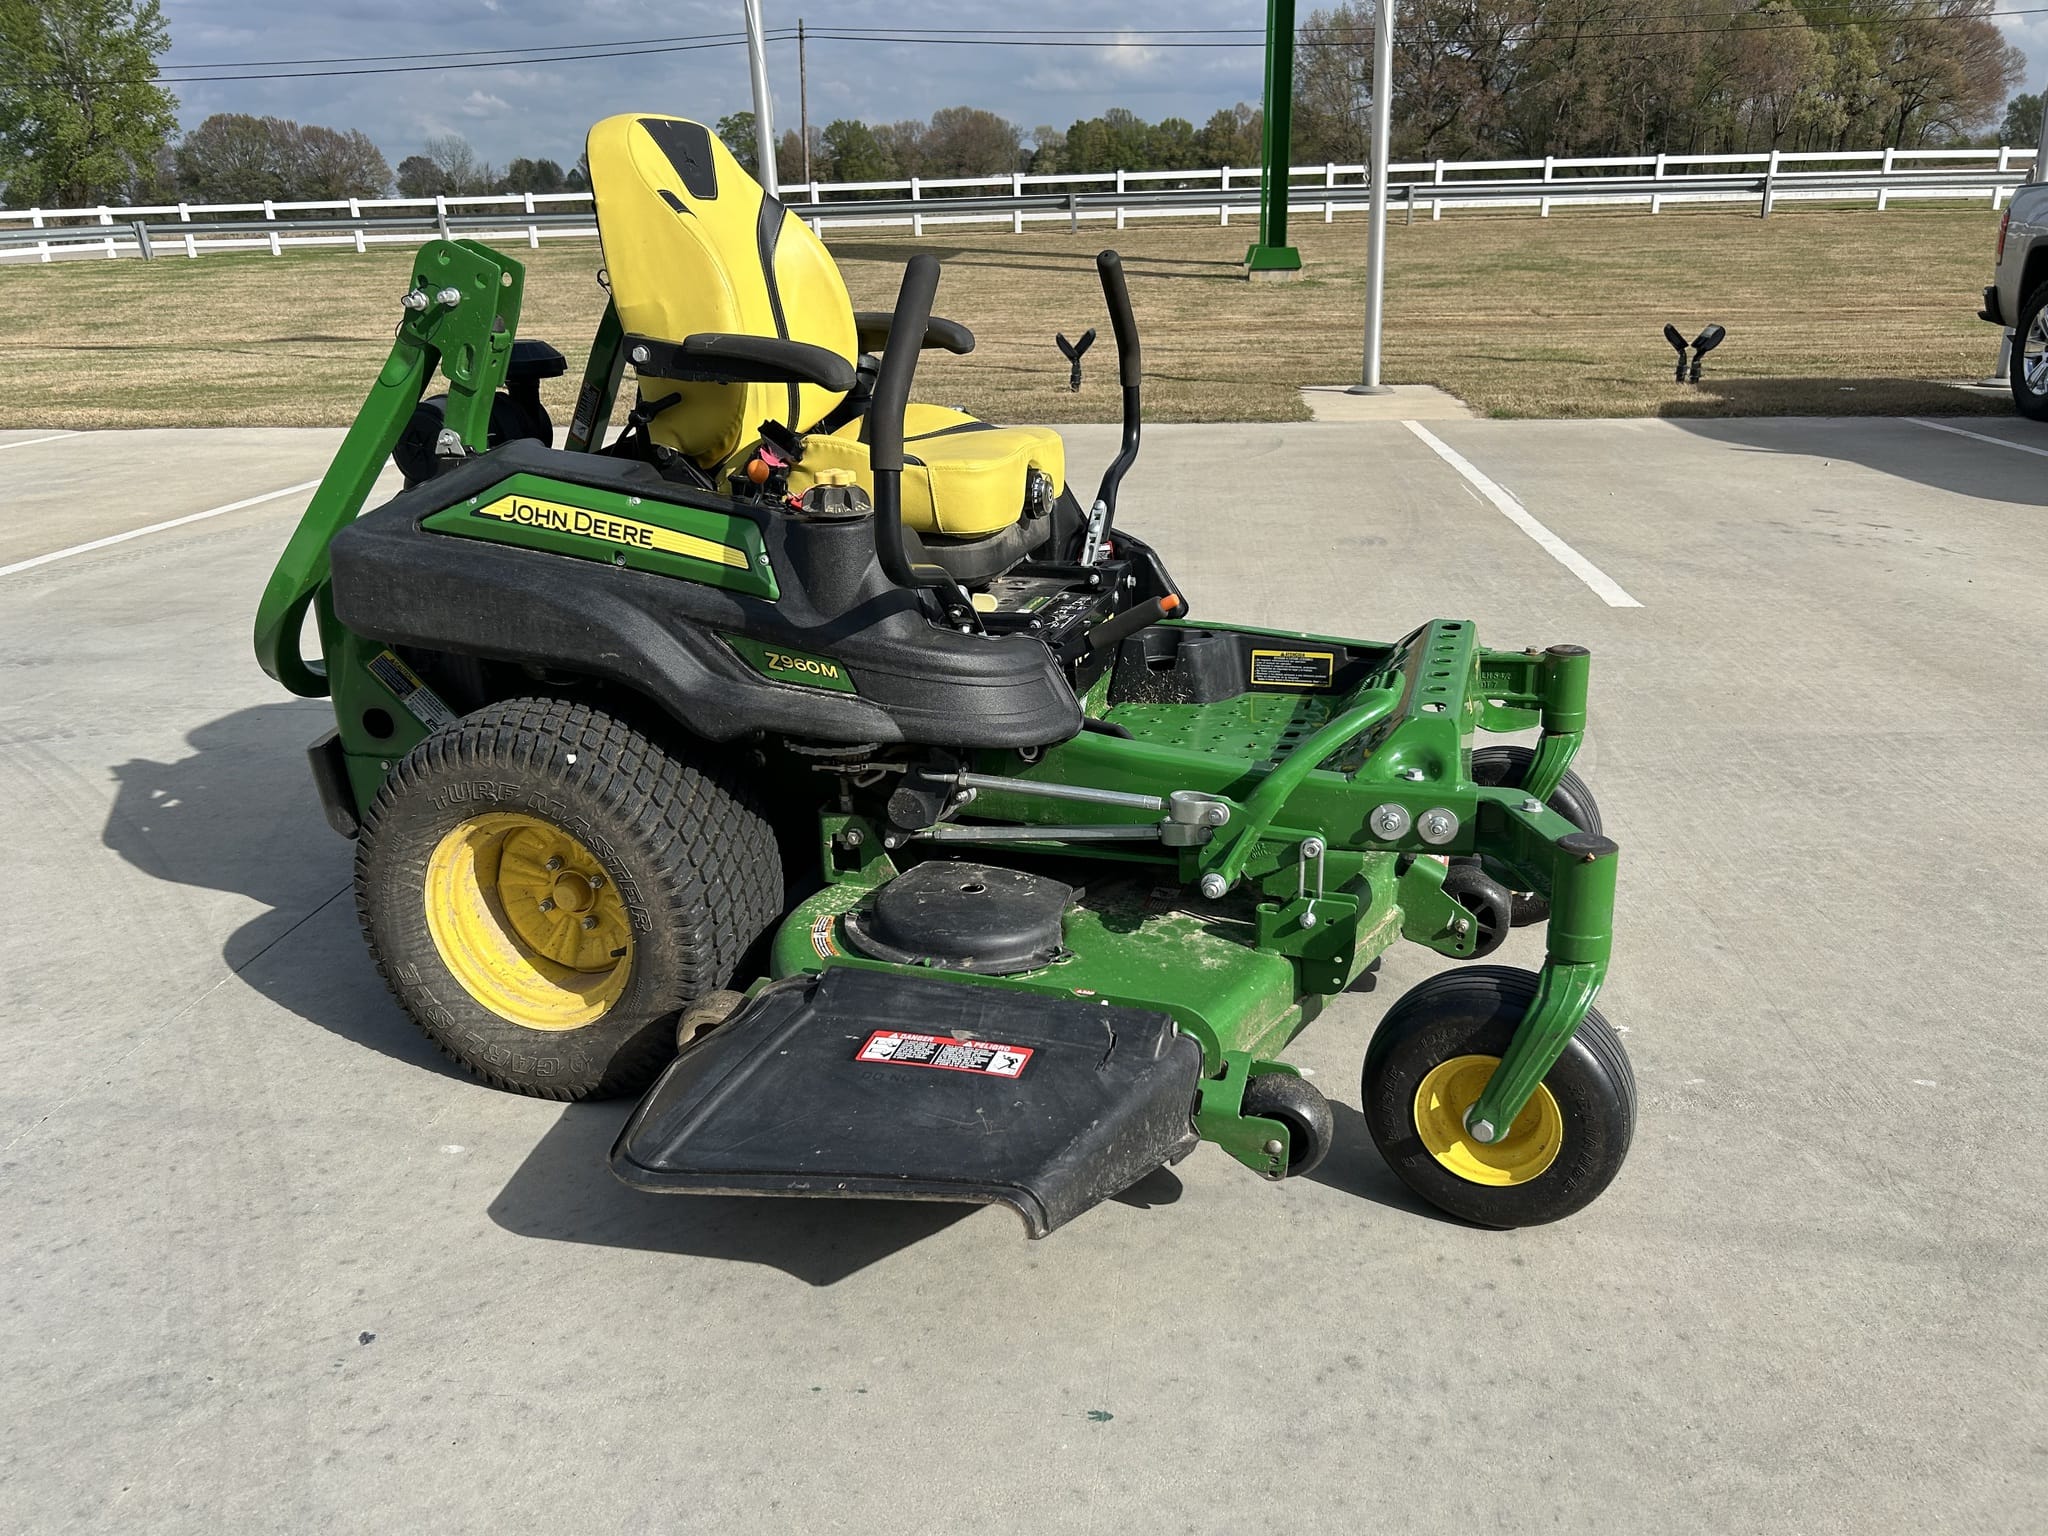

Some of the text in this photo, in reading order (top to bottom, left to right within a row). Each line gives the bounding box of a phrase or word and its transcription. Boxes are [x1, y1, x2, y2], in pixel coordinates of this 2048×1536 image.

[503, 499, 654, 547] JOHN DEERE
[764, 651, 839, 679] Z960M
[427, 780, 653, 933] TURF MASTER
[394, 961, 560, 1077] CARLISLE
[899, 1032, 934, 1043] DANGER
[973, 1041, 1011, 1052] PELIGRO
